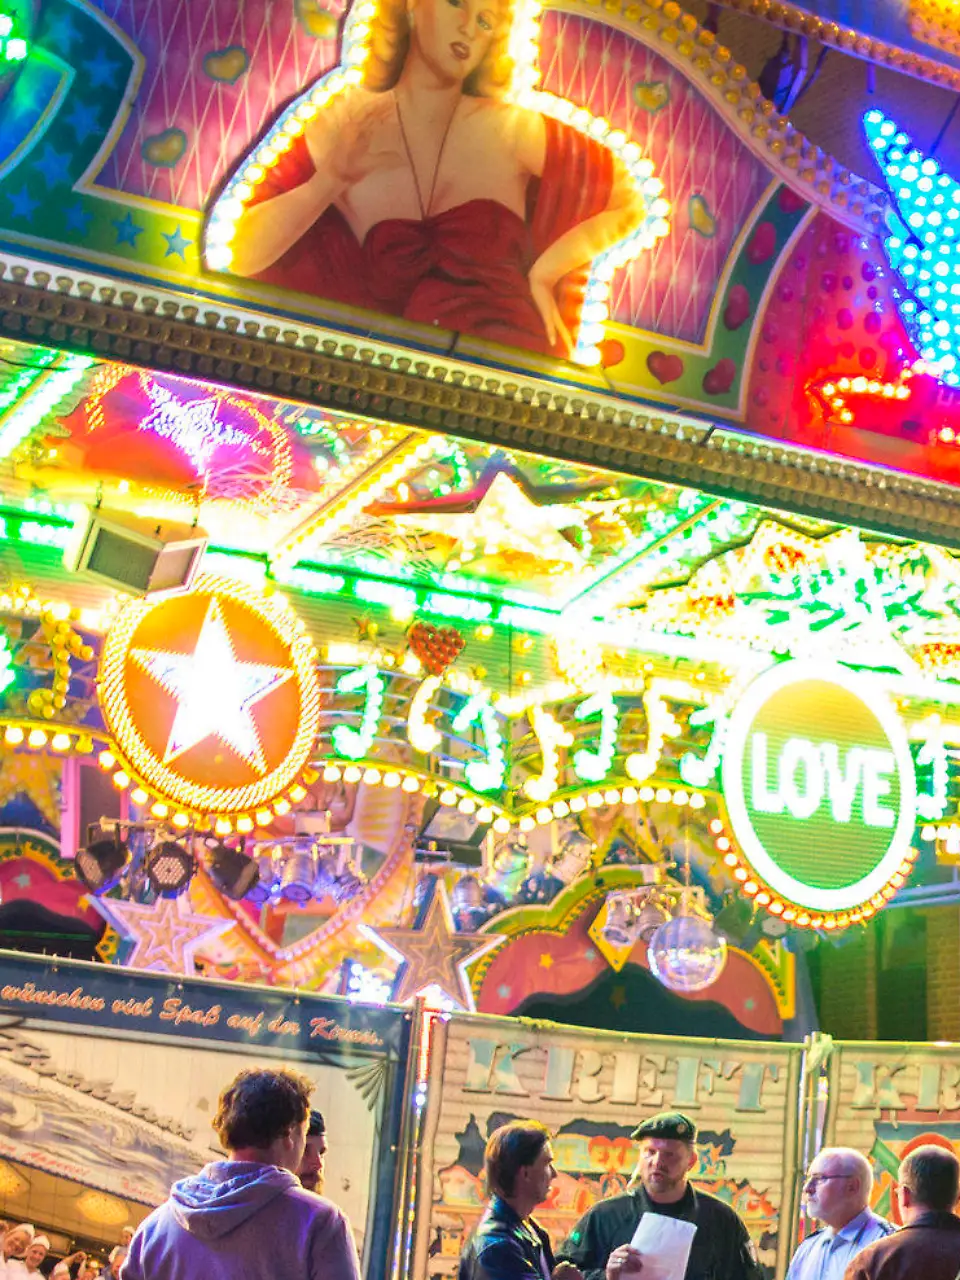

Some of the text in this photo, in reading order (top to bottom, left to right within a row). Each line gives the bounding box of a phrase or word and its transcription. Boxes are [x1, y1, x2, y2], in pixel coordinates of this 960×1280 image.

[752, 732, 895, 828] LOVE
[1, 982, 105, 1011] wünschen
[112, 997, 153, 1017] viel
[159, 998, 222, 1026] Spaß
[226, 1011, 265, 1037] auf
[267, 1014, 300, 1036] der
[462, 1038, 780, 1113] KREFT
